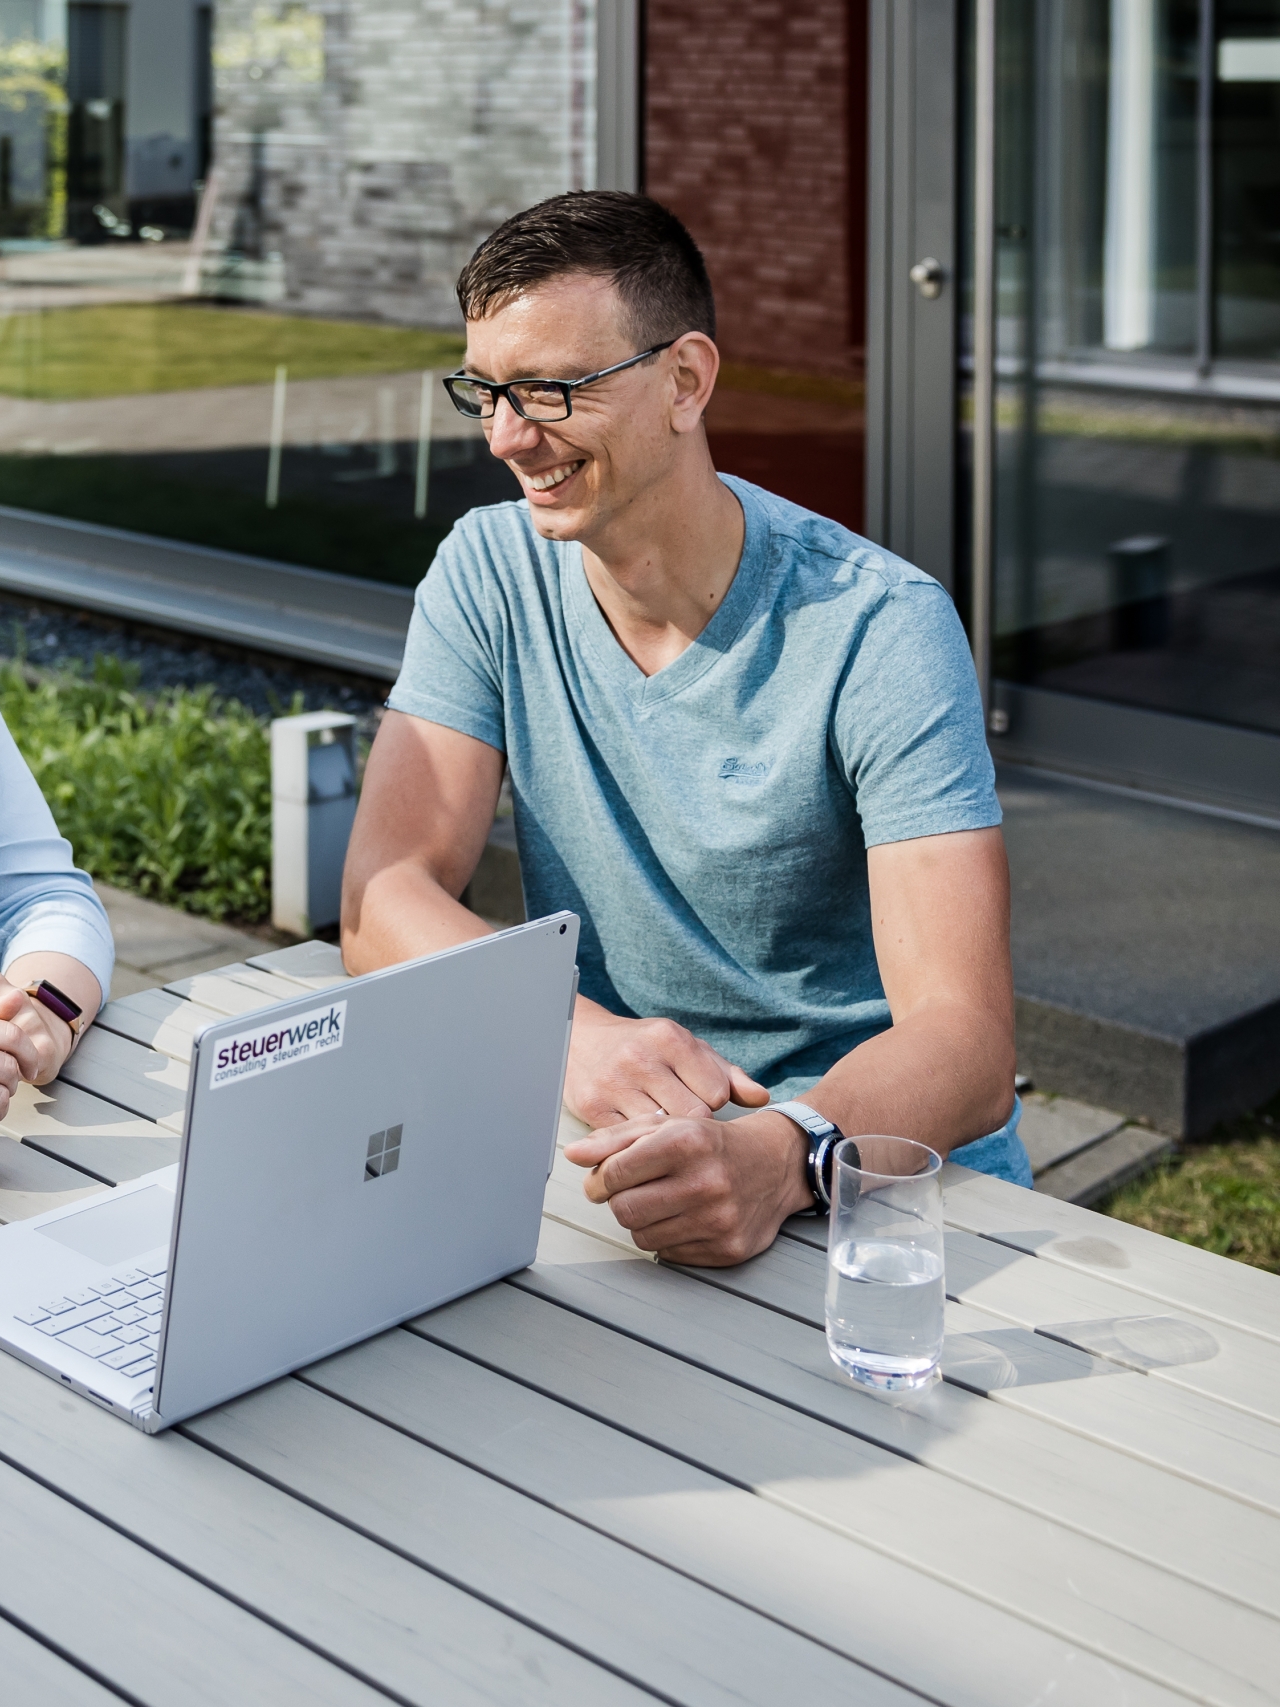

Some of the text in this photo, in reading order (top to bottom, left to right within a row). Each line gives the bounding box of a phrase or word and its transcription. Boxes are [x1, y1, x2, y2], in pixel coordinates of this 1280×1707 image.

[215, 1032, 340, 1081] consulting steuern recht
[217, 1008, 340, 1068] steuerwerk
